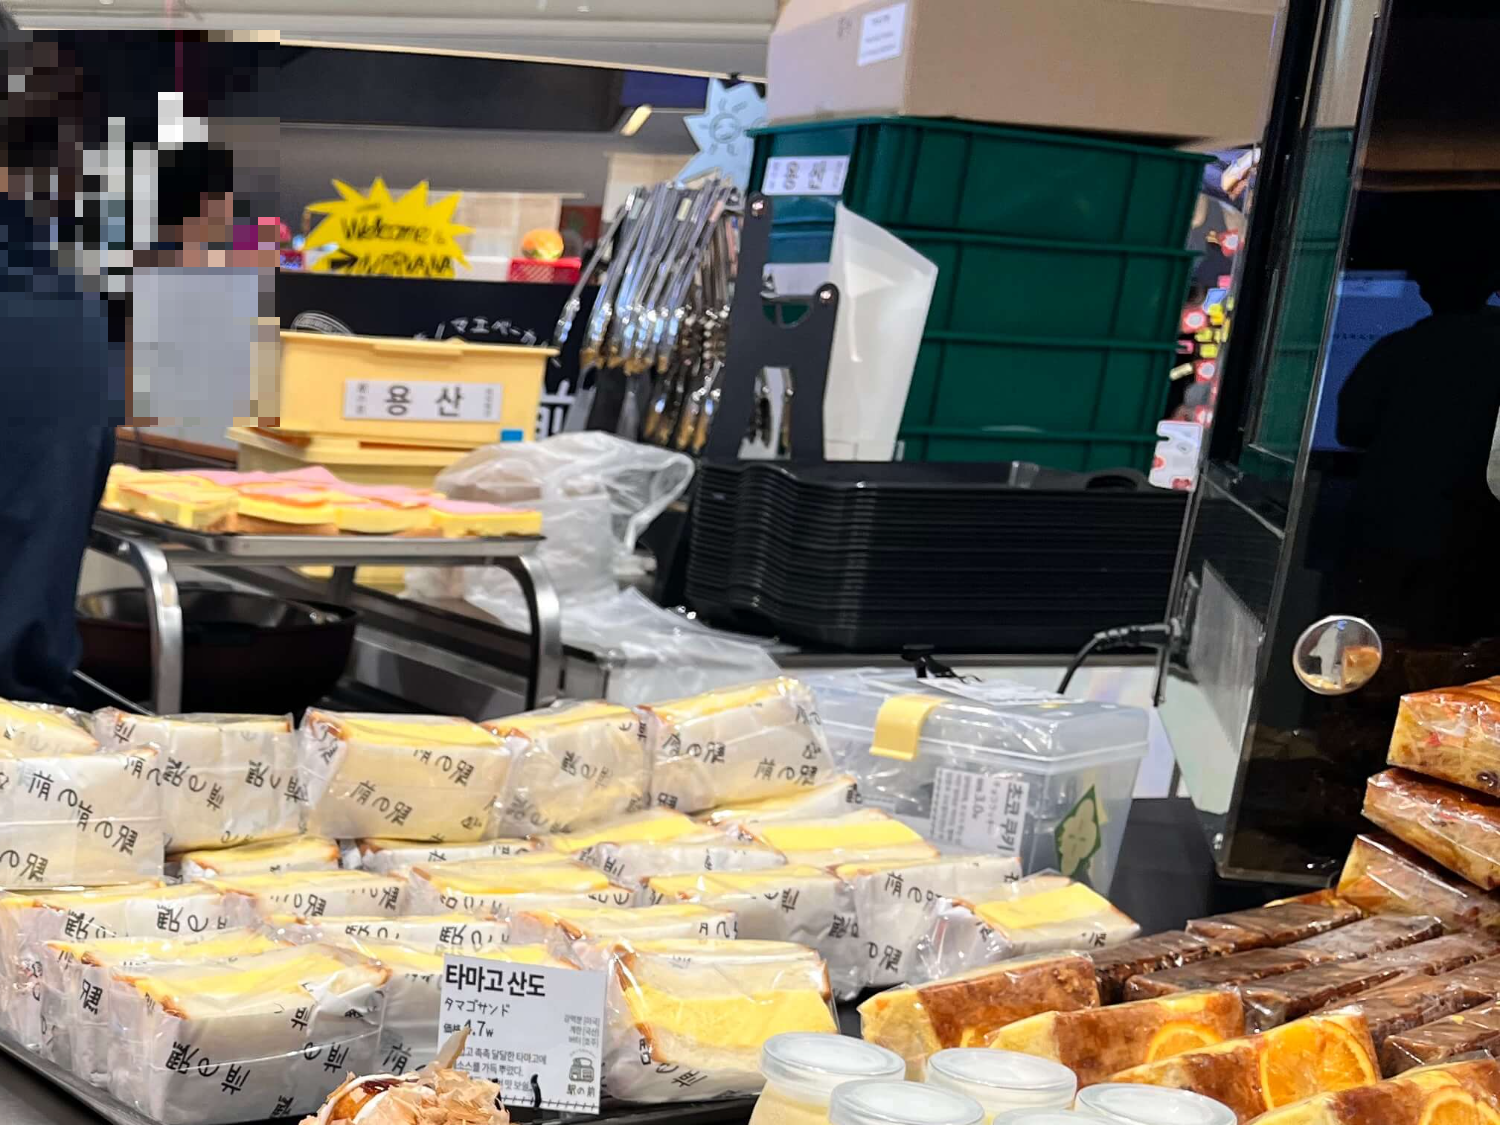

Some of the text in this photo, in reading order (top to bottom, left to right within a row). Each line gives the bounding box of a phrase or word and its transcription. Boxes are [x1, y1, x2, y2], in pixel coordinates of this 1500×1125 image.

[445, 964, 546, 997] 타마고 산도
[445, 997, 510, 1017] タマゴサンド
